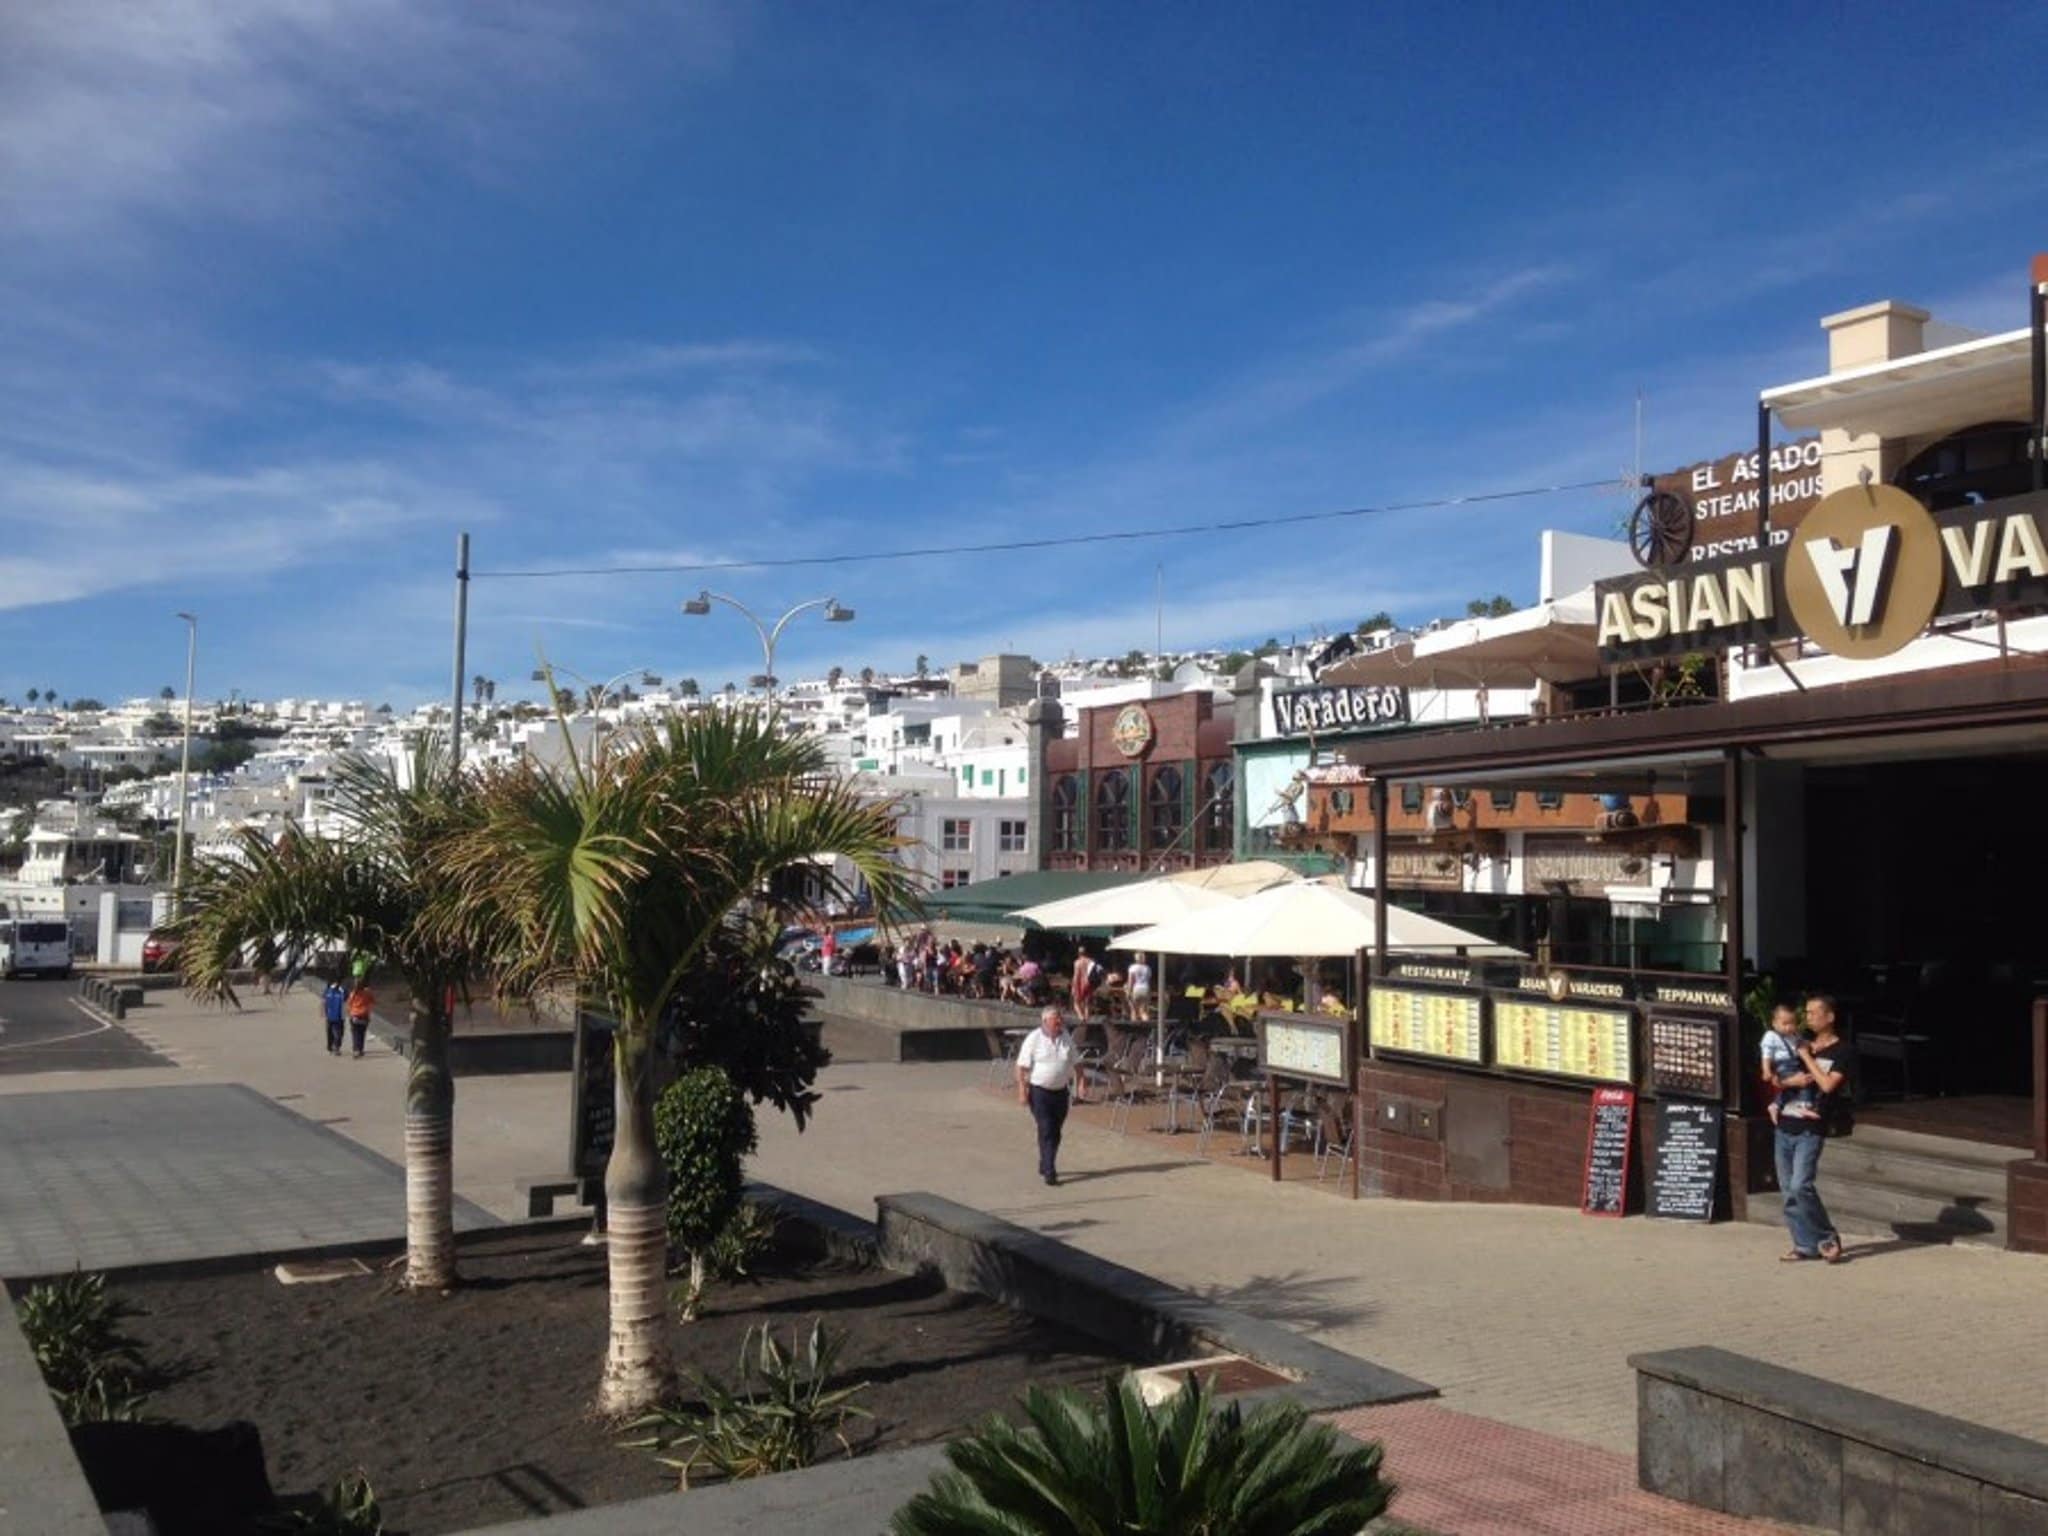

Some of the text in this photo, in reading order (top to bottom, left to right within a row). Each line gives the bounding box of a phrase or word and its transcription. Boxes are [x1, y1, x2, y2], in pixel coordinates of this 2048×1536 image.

[1692, 441, 1822, 492] EL ASADO
[1695, 488, 1761, 520] STEAK
[1597, 562, 1774, 648] ASIAN
[1277, 686, 1397, 735] Varadero
[1401, 964, 1470, 984] RESTAURANTE
[1519, 977, 1547, 991] ASIAN
[1569, 982, 1624, 998] VARADERO
